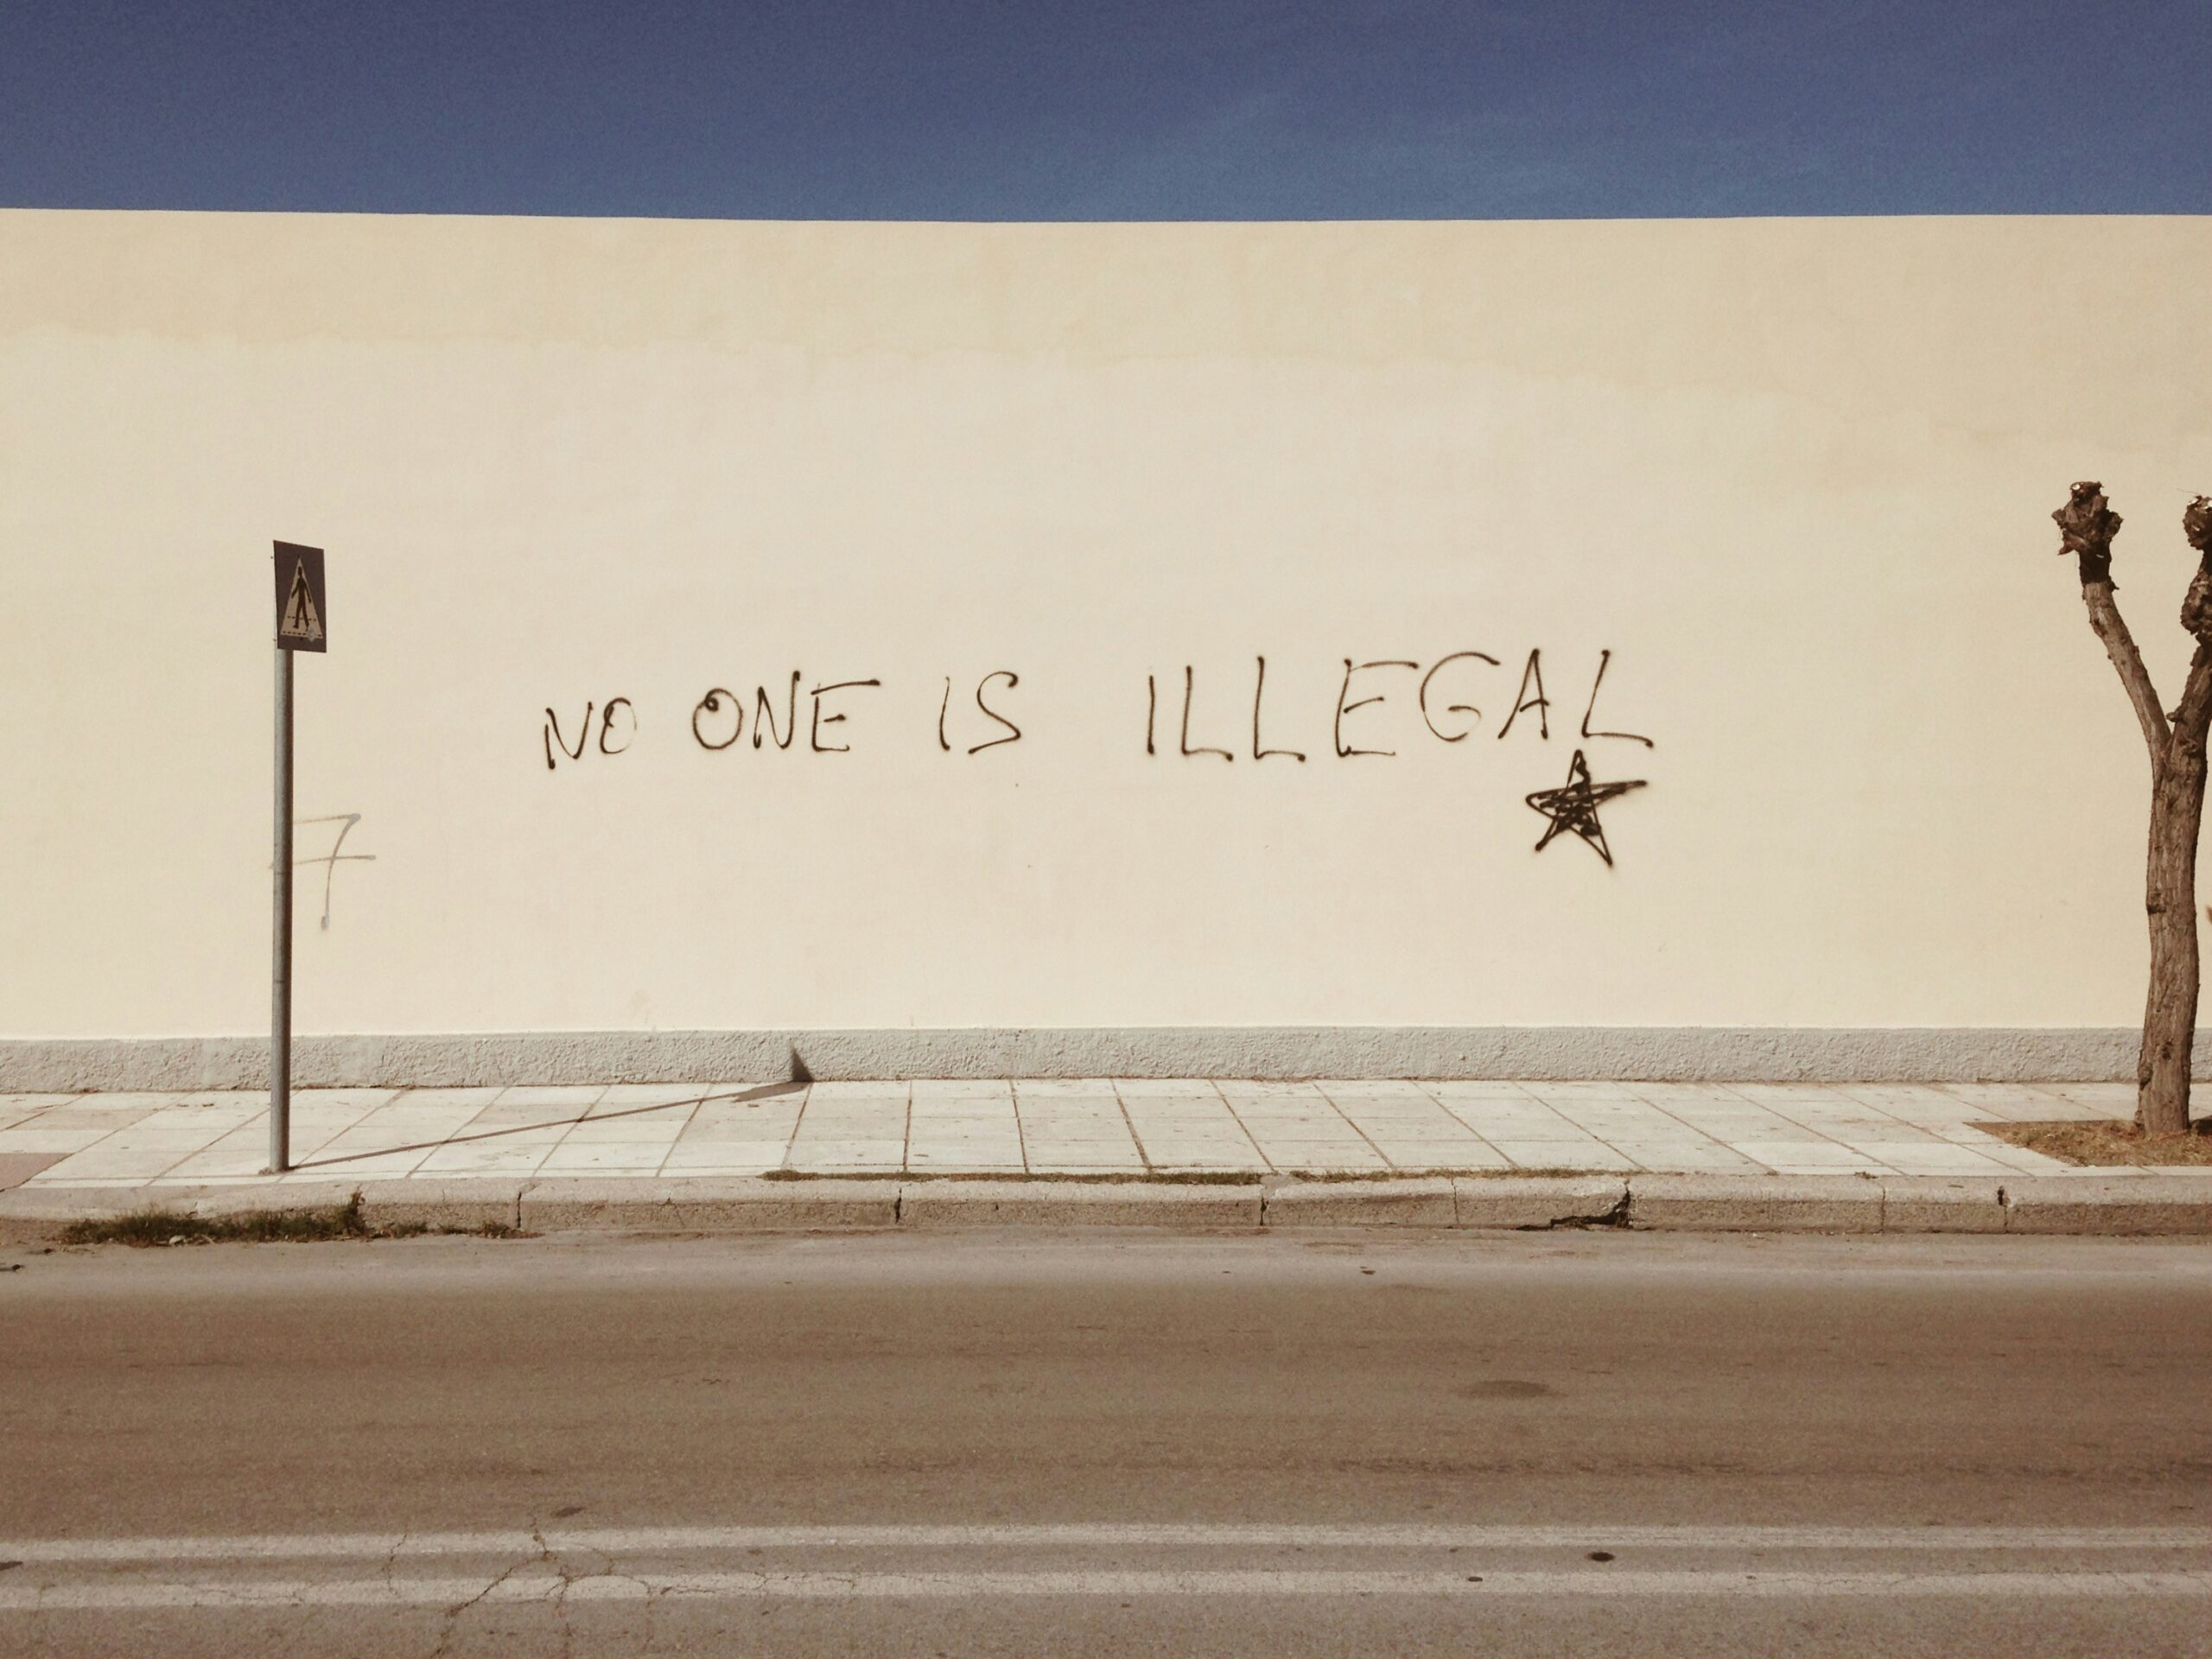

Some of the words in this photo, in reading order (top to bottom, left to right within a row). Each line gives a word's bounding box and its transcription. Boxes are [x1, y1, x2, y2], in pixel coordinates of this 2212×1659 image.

[543, 696, 638, 771] NO
[691, 670, 880, 753] ONE
[938, 671, 1022, 756] IS
[1146, 647, 1654, 764] ILLEGAL
